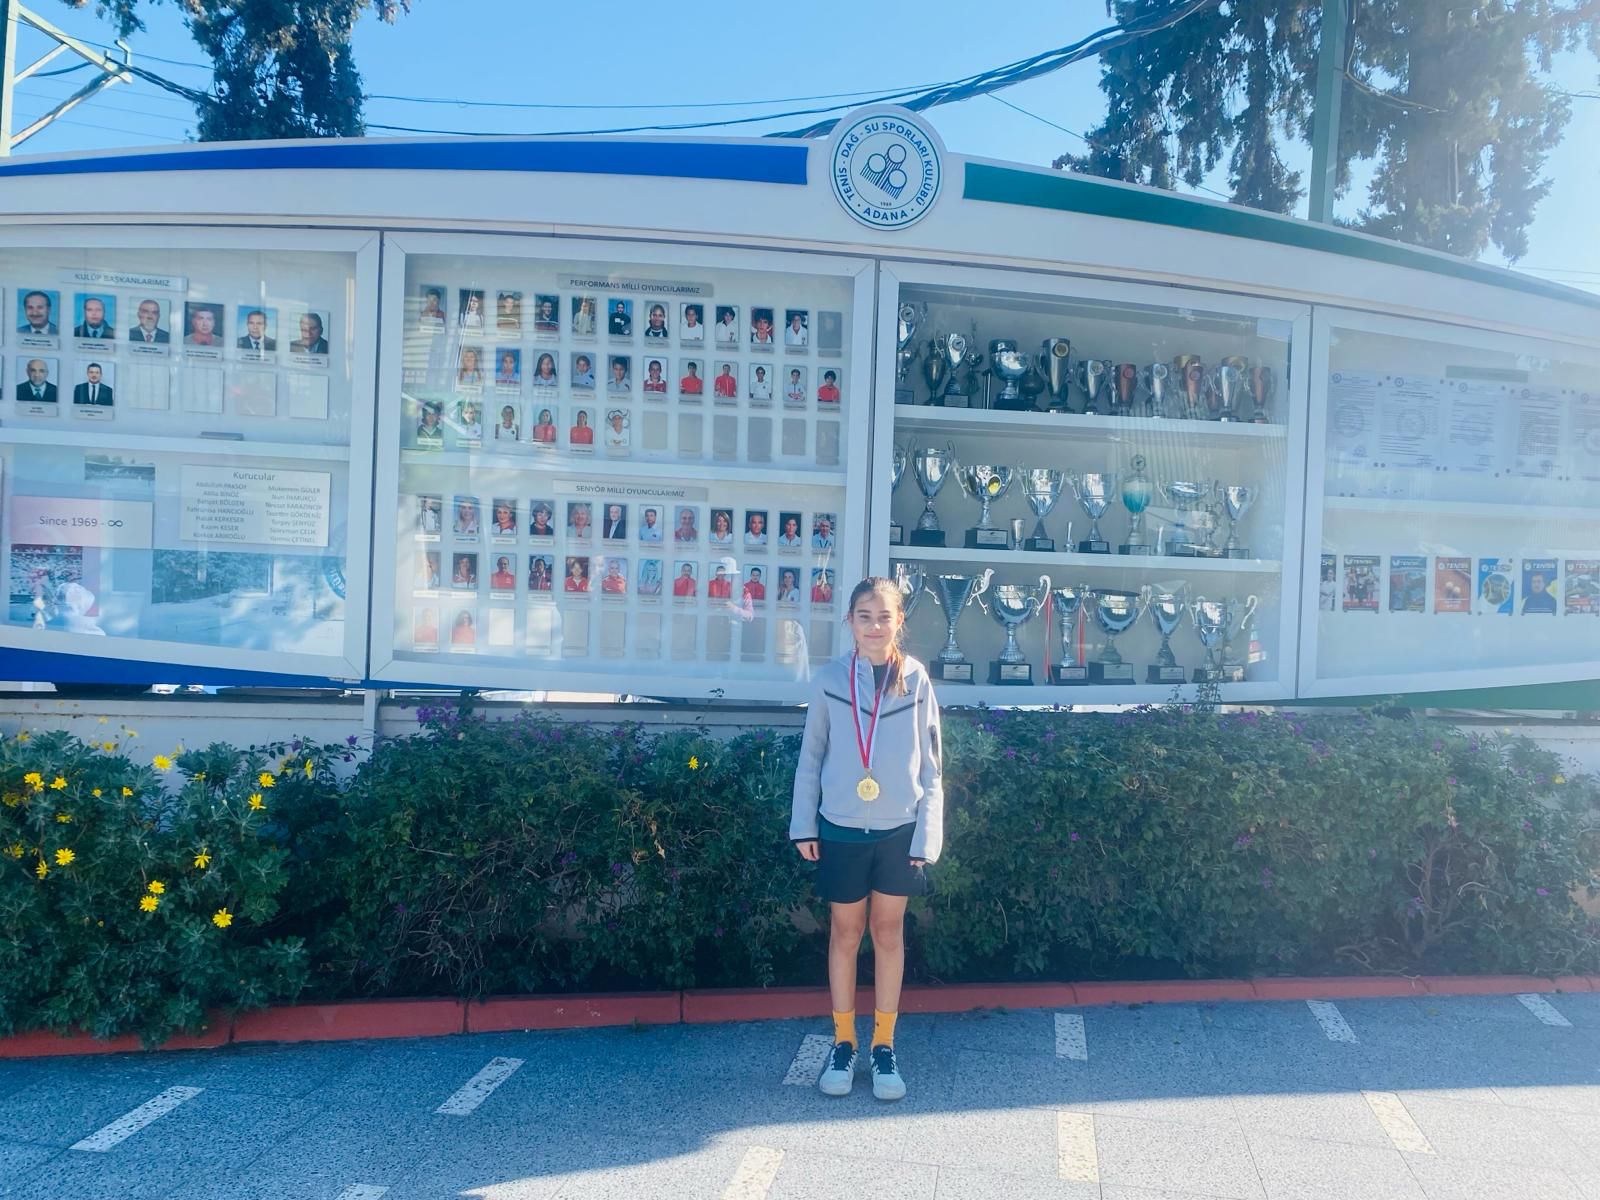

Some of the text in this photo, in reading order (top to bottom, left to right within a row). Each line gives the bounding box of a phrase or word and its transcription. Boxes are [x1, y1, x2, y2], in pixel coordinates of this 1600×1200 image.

[837, 121, 934, 206] TENİS DAĞ SU SPORLARI KULÜBÜ
[863, 207, 908, 221] ADANA
[570, 279, 620, 289] PERFORMANS
[641, 284, 701, 293] OYUNCULARIMIZ
[233, 471, 275, 481] Kurucular
[576, 485, 606, 493] SENYÖR
[626, 488, 685, 497] OYUNCULARIMIZ
[39, 516, 98, 527] Since 1969
